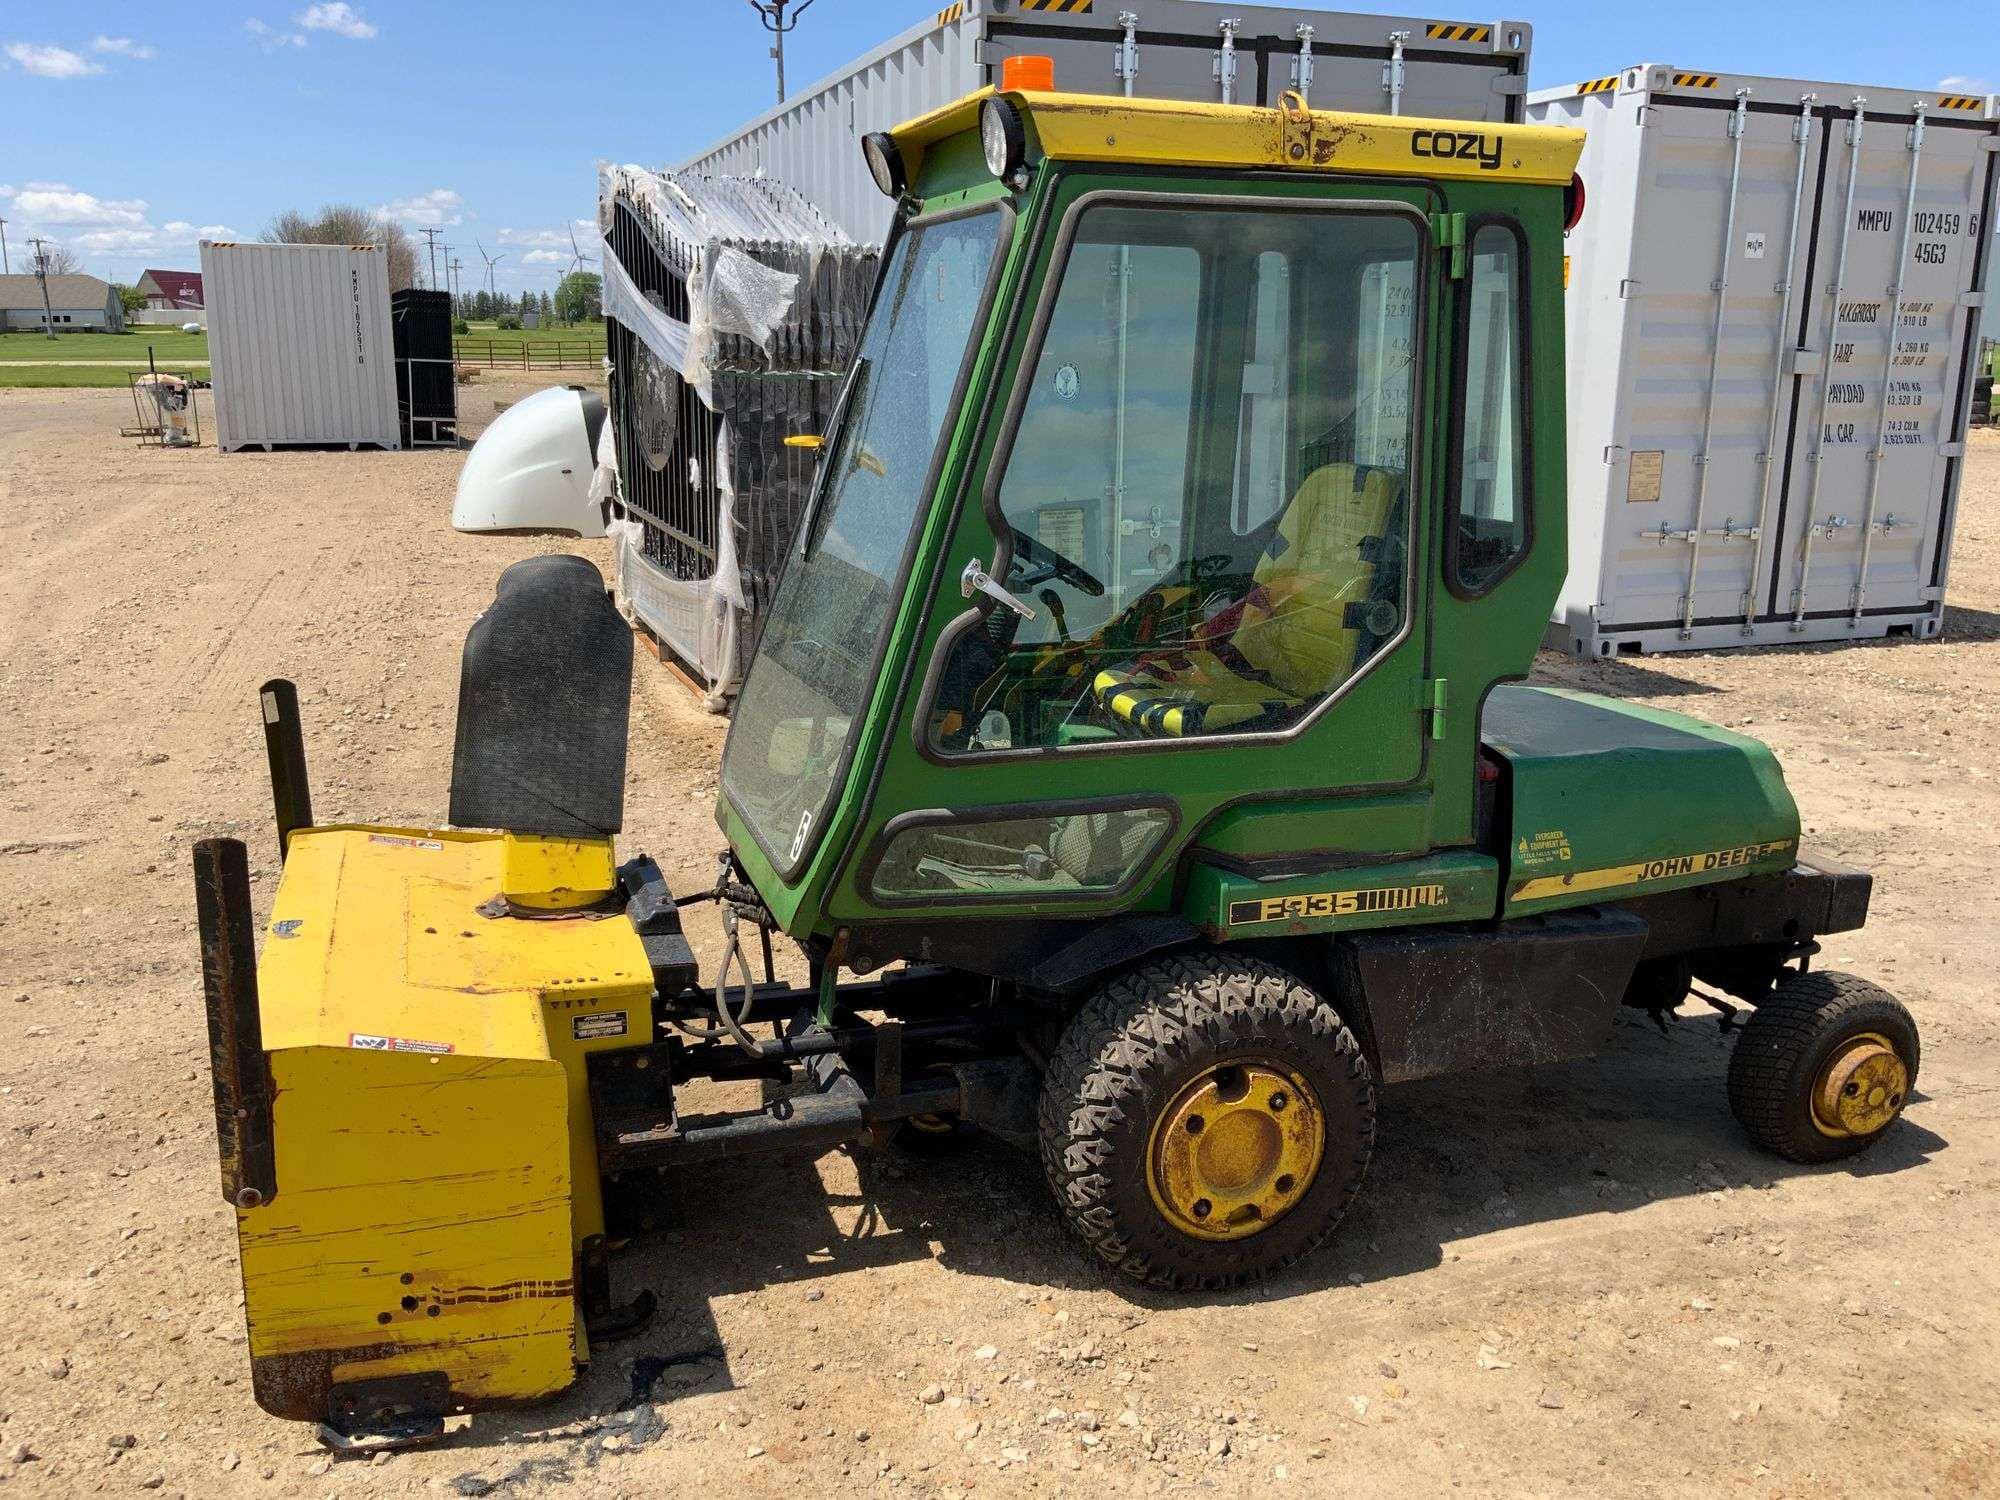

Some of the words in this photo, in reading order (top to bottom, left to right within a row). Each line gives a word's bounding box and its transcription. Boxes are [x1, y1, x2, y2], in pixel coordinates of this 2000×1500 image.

[1857, 209, 1893, 232] MMPU
[1914, 212, 1960, 235] 102459
[1969, 214, 1979, 237] 6
[1914, 243, 1946, 264] 45G3
[1638, 856, 1694, 880] JOHN
